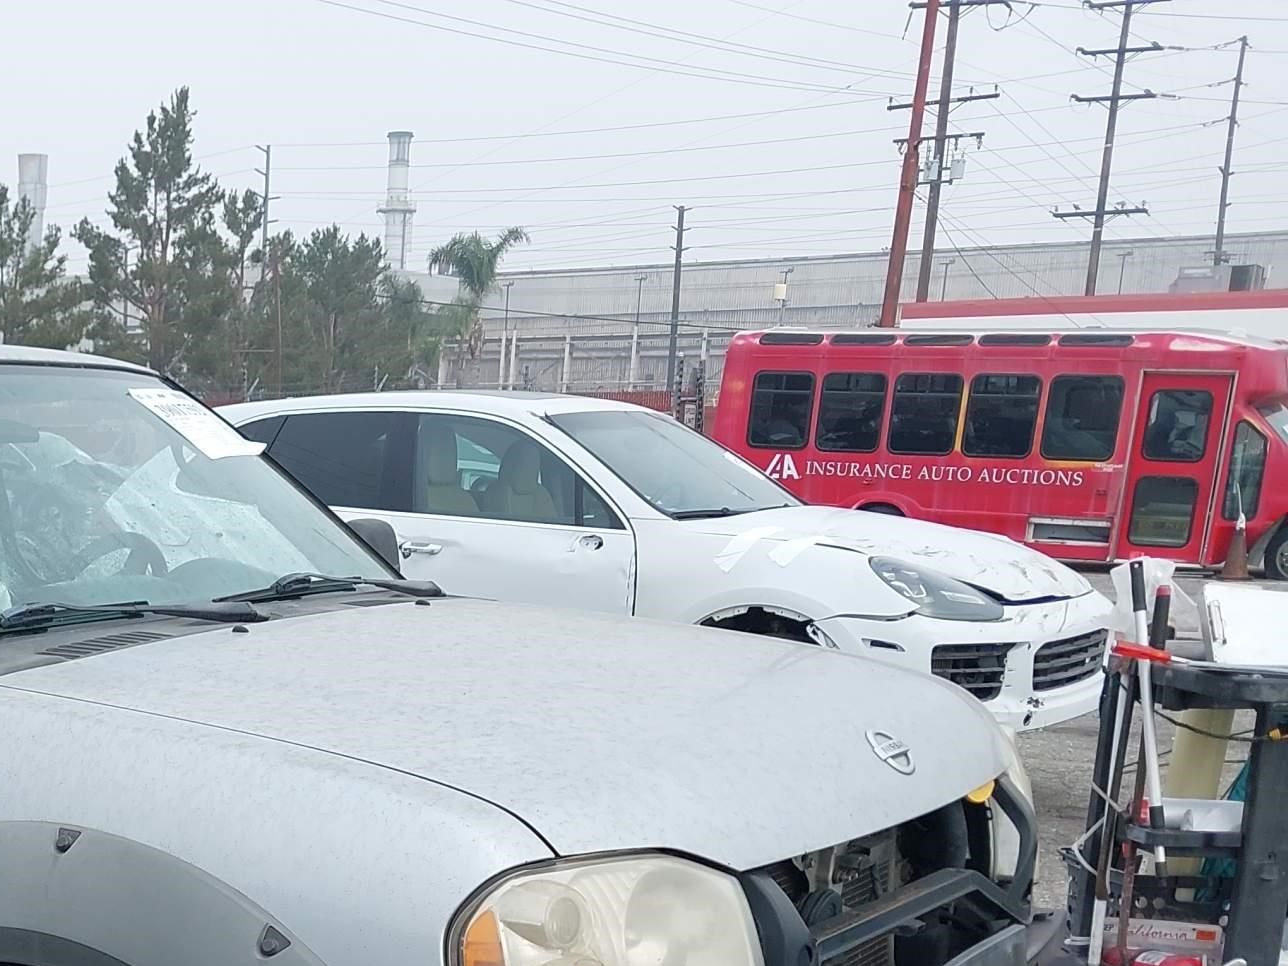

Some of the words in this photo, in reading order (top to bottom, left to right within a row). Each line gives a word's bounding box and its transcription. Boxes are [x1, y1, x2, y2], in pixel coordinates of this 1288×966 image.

[806, 461, 912, 479] INSURANCE
[917, 465, 972, 481] AUTO
[977, 468, 1083, 486] AUCTIONS
